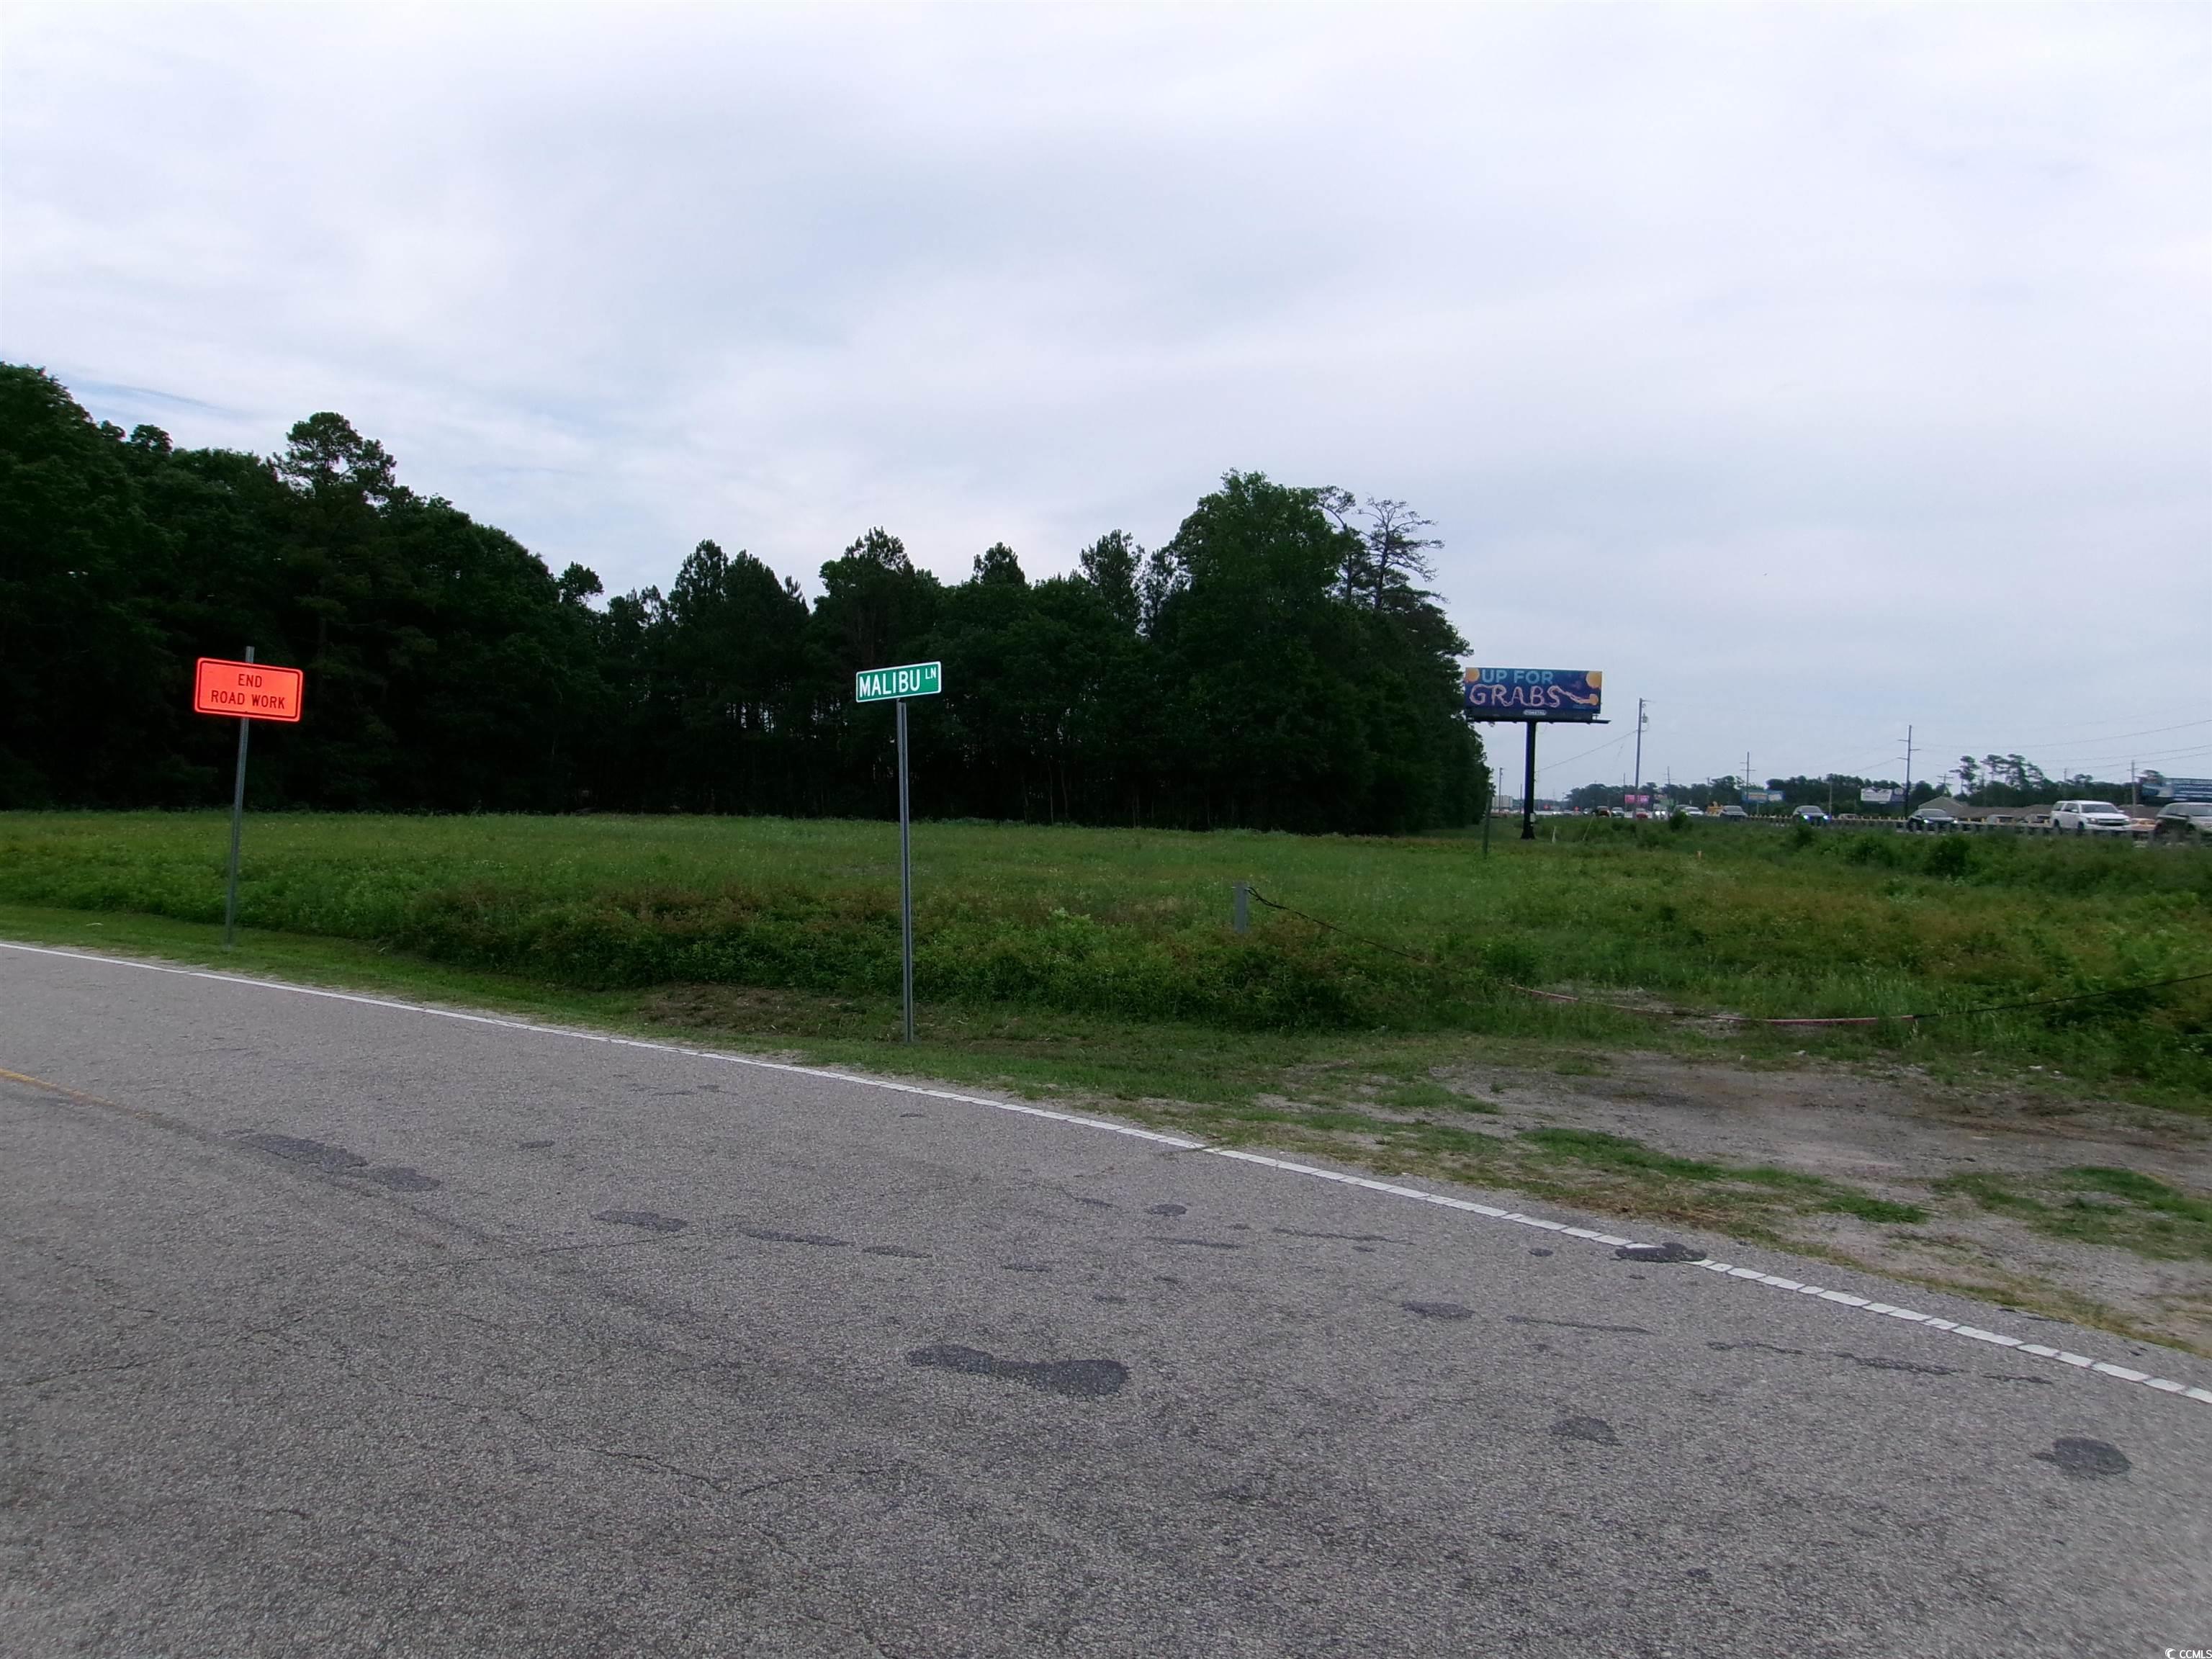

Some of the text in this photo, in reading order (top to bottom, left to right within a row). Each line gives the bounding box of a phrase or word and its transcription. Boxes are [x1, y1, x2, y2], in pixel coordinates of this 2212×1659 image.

[238, 673, 263, 688] END
[859, 667, 937, 698] MALIBU LN
[1481, 669, 1553, 684] UP FOR
[211, 690, 285, 709] ROAD WORK
[1469, 683, 1561, 708] GRABS
